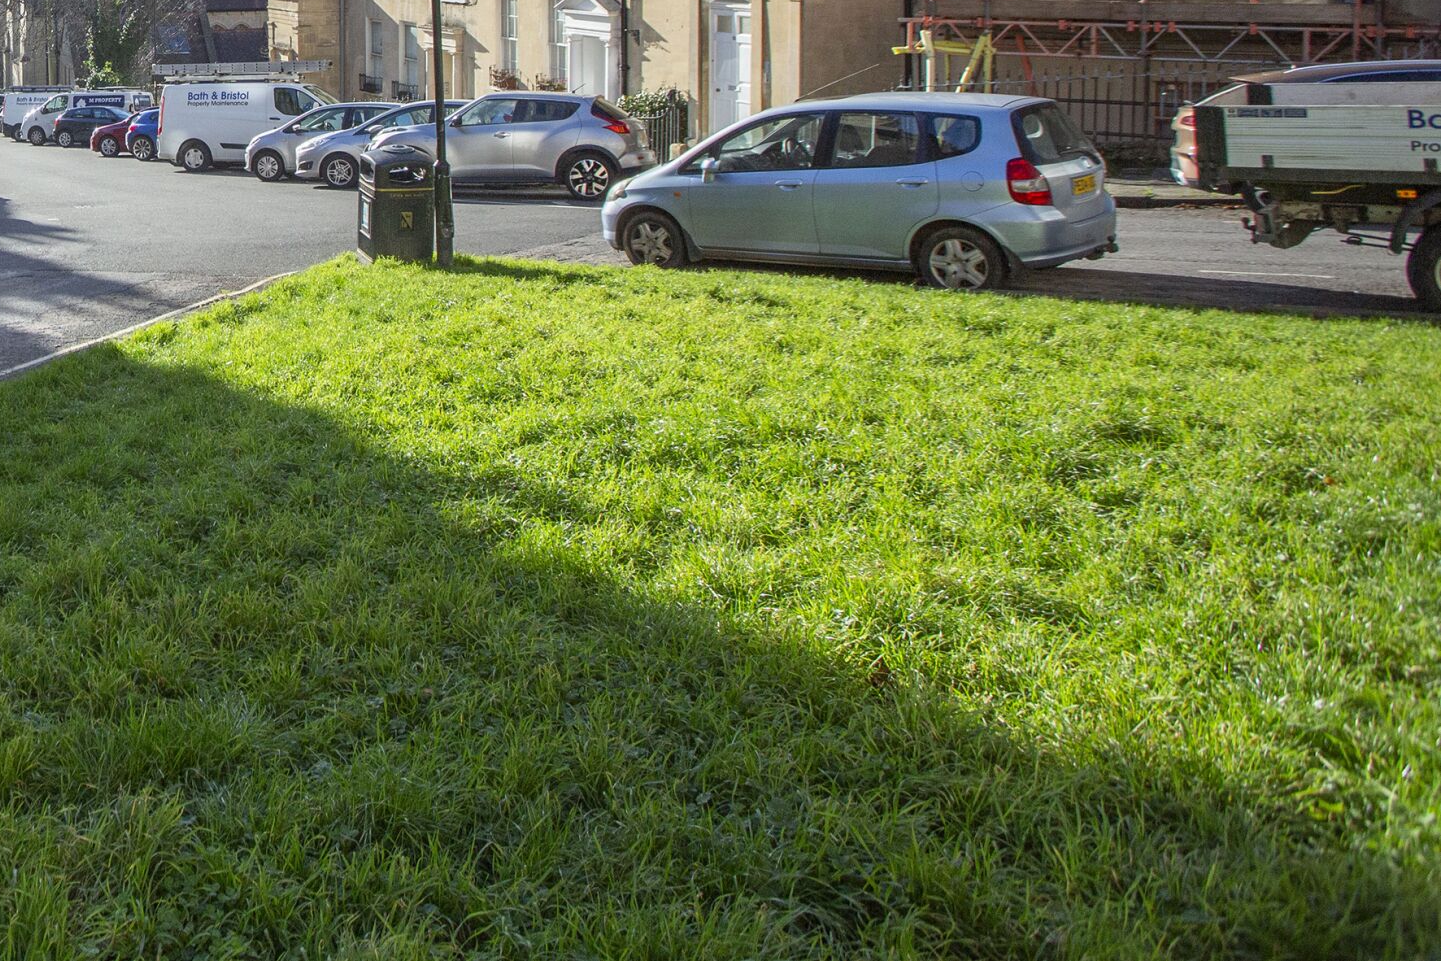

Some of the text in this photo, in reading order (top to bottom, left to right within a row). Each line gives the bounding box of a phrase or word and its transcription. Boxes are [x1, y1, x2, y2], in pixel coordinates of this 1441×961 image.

[188, 91, 249, 101] Bath & Bristol
